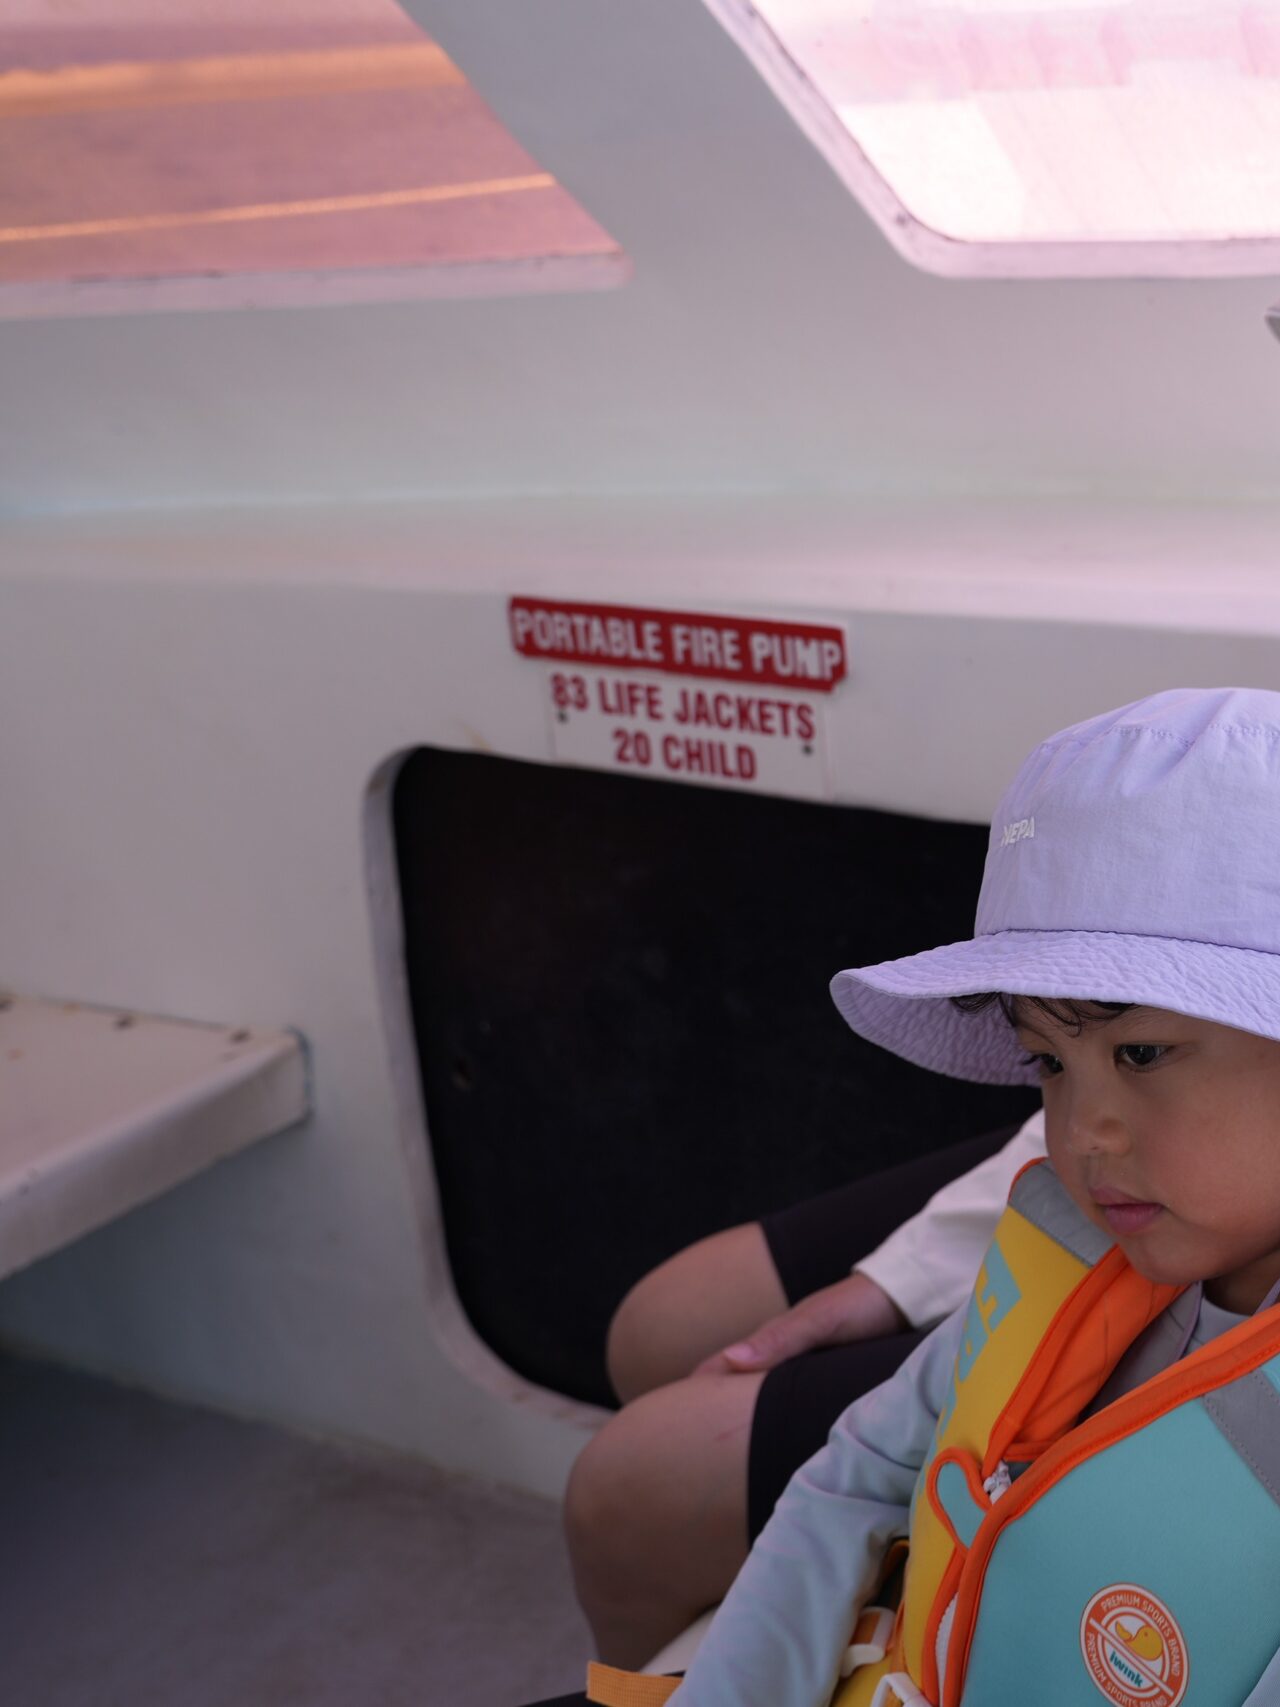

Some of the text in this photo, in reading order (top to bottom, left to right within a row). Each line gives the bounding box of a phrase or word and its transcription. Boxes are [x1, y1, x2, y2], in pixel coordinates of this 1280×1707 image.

[513, 608, 841, 681] PORTABLE FIRE PUMP
[551, 673, 815, 741] 83 LIFE JACKETS
[612, 729, 757, 780] 20 CHILD
[1101, 1594, 1180, 1677] PREMIUM SPORTS BRAND
